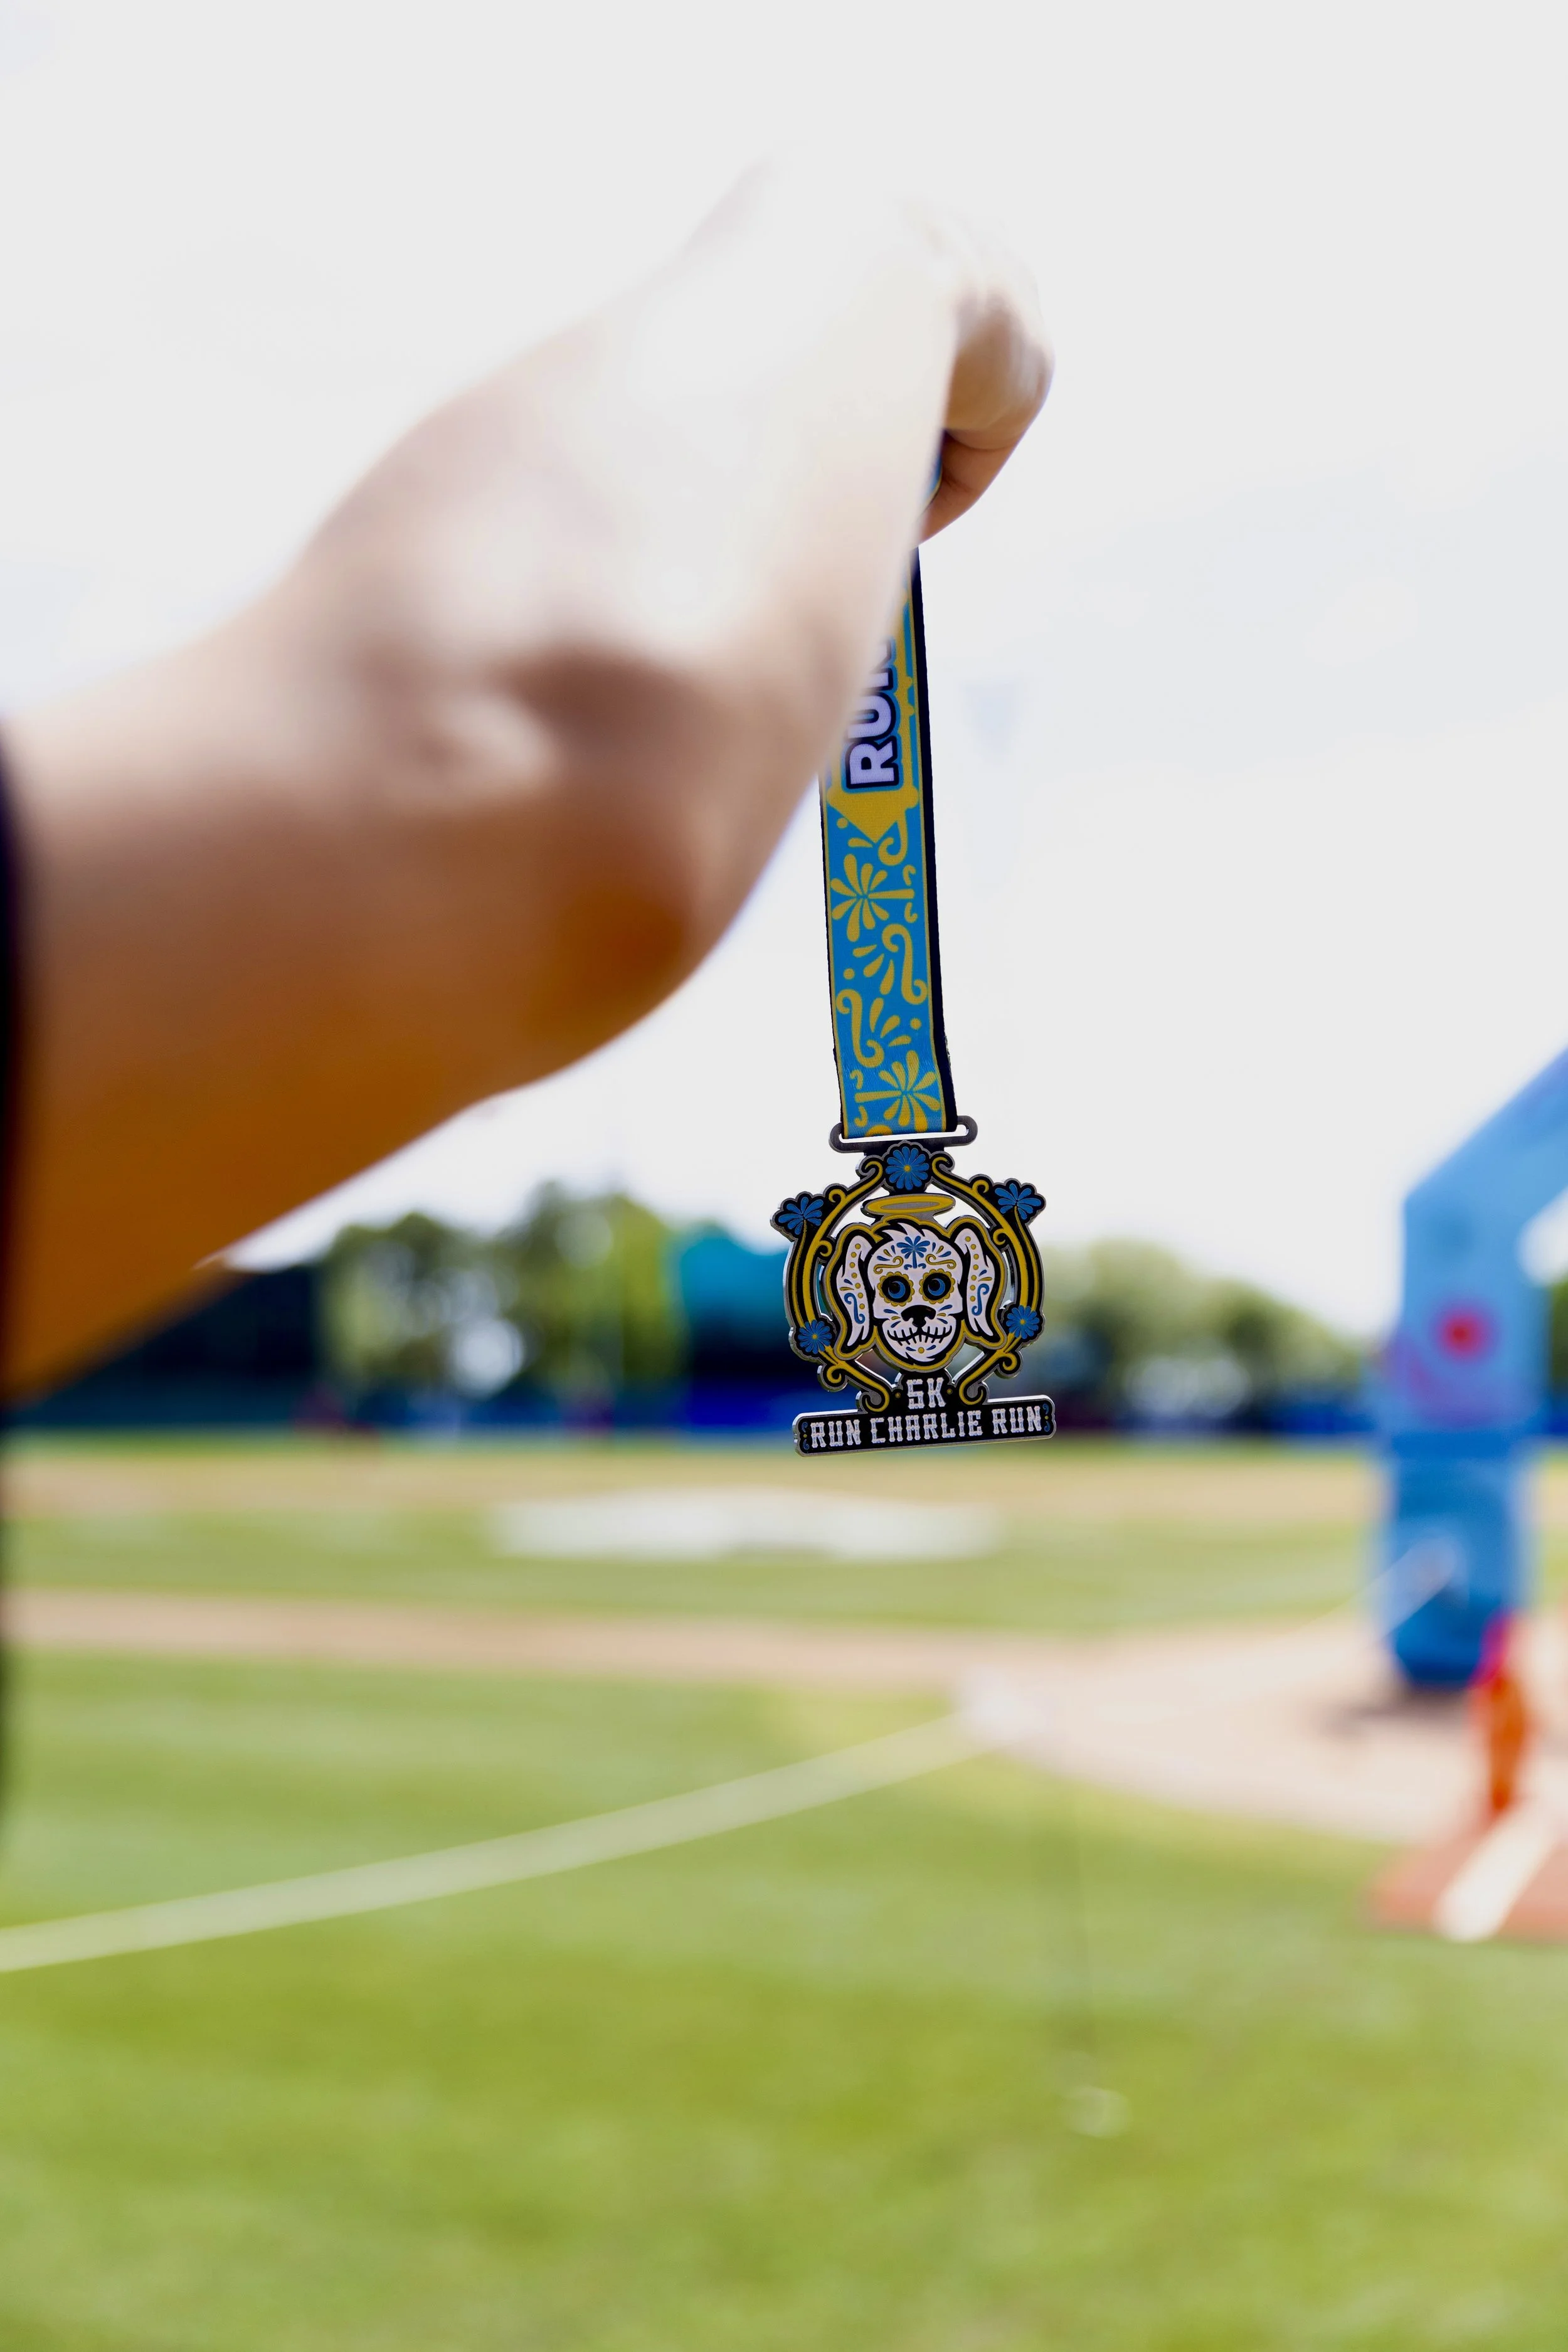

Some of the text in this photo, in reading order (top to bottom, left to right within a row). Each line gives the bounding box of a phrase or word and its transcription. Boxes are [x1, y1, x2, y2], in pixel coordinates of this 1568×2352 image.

[906, 1377, 946, 1409] 5K
[810, 1406, 1042, 1448] RUN CHARLIE RUN
